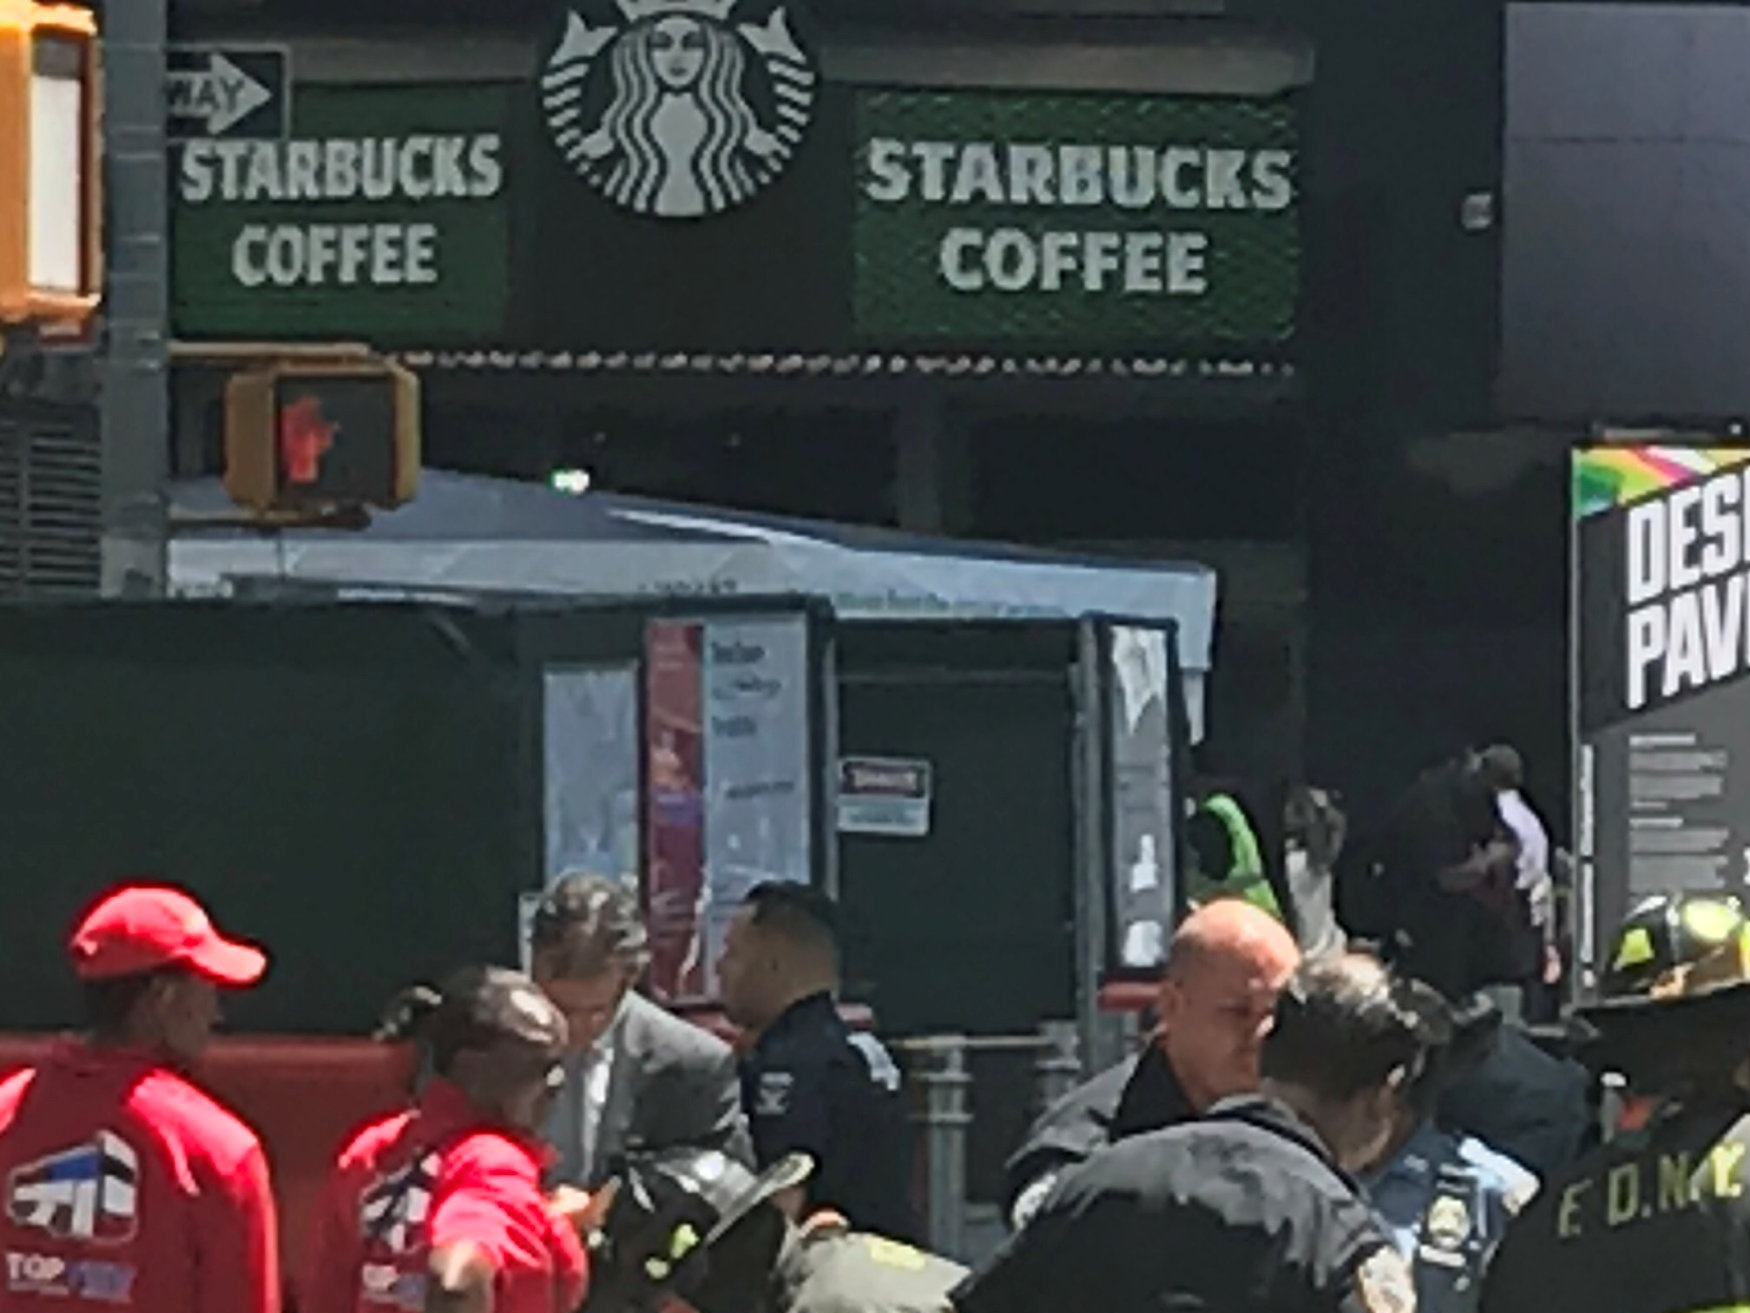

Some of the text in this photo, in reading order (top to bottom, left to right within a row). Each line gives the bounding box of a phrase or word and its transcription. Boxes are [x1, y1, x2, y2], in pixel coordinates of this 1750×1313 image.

[180, 134, 502, 200] STARBUCKS
[866, 137, 1292, 210] STARBUCKS
[231, 223, 438, 286] COFFEE
[940, 227, 1207, 293] COFFEE
